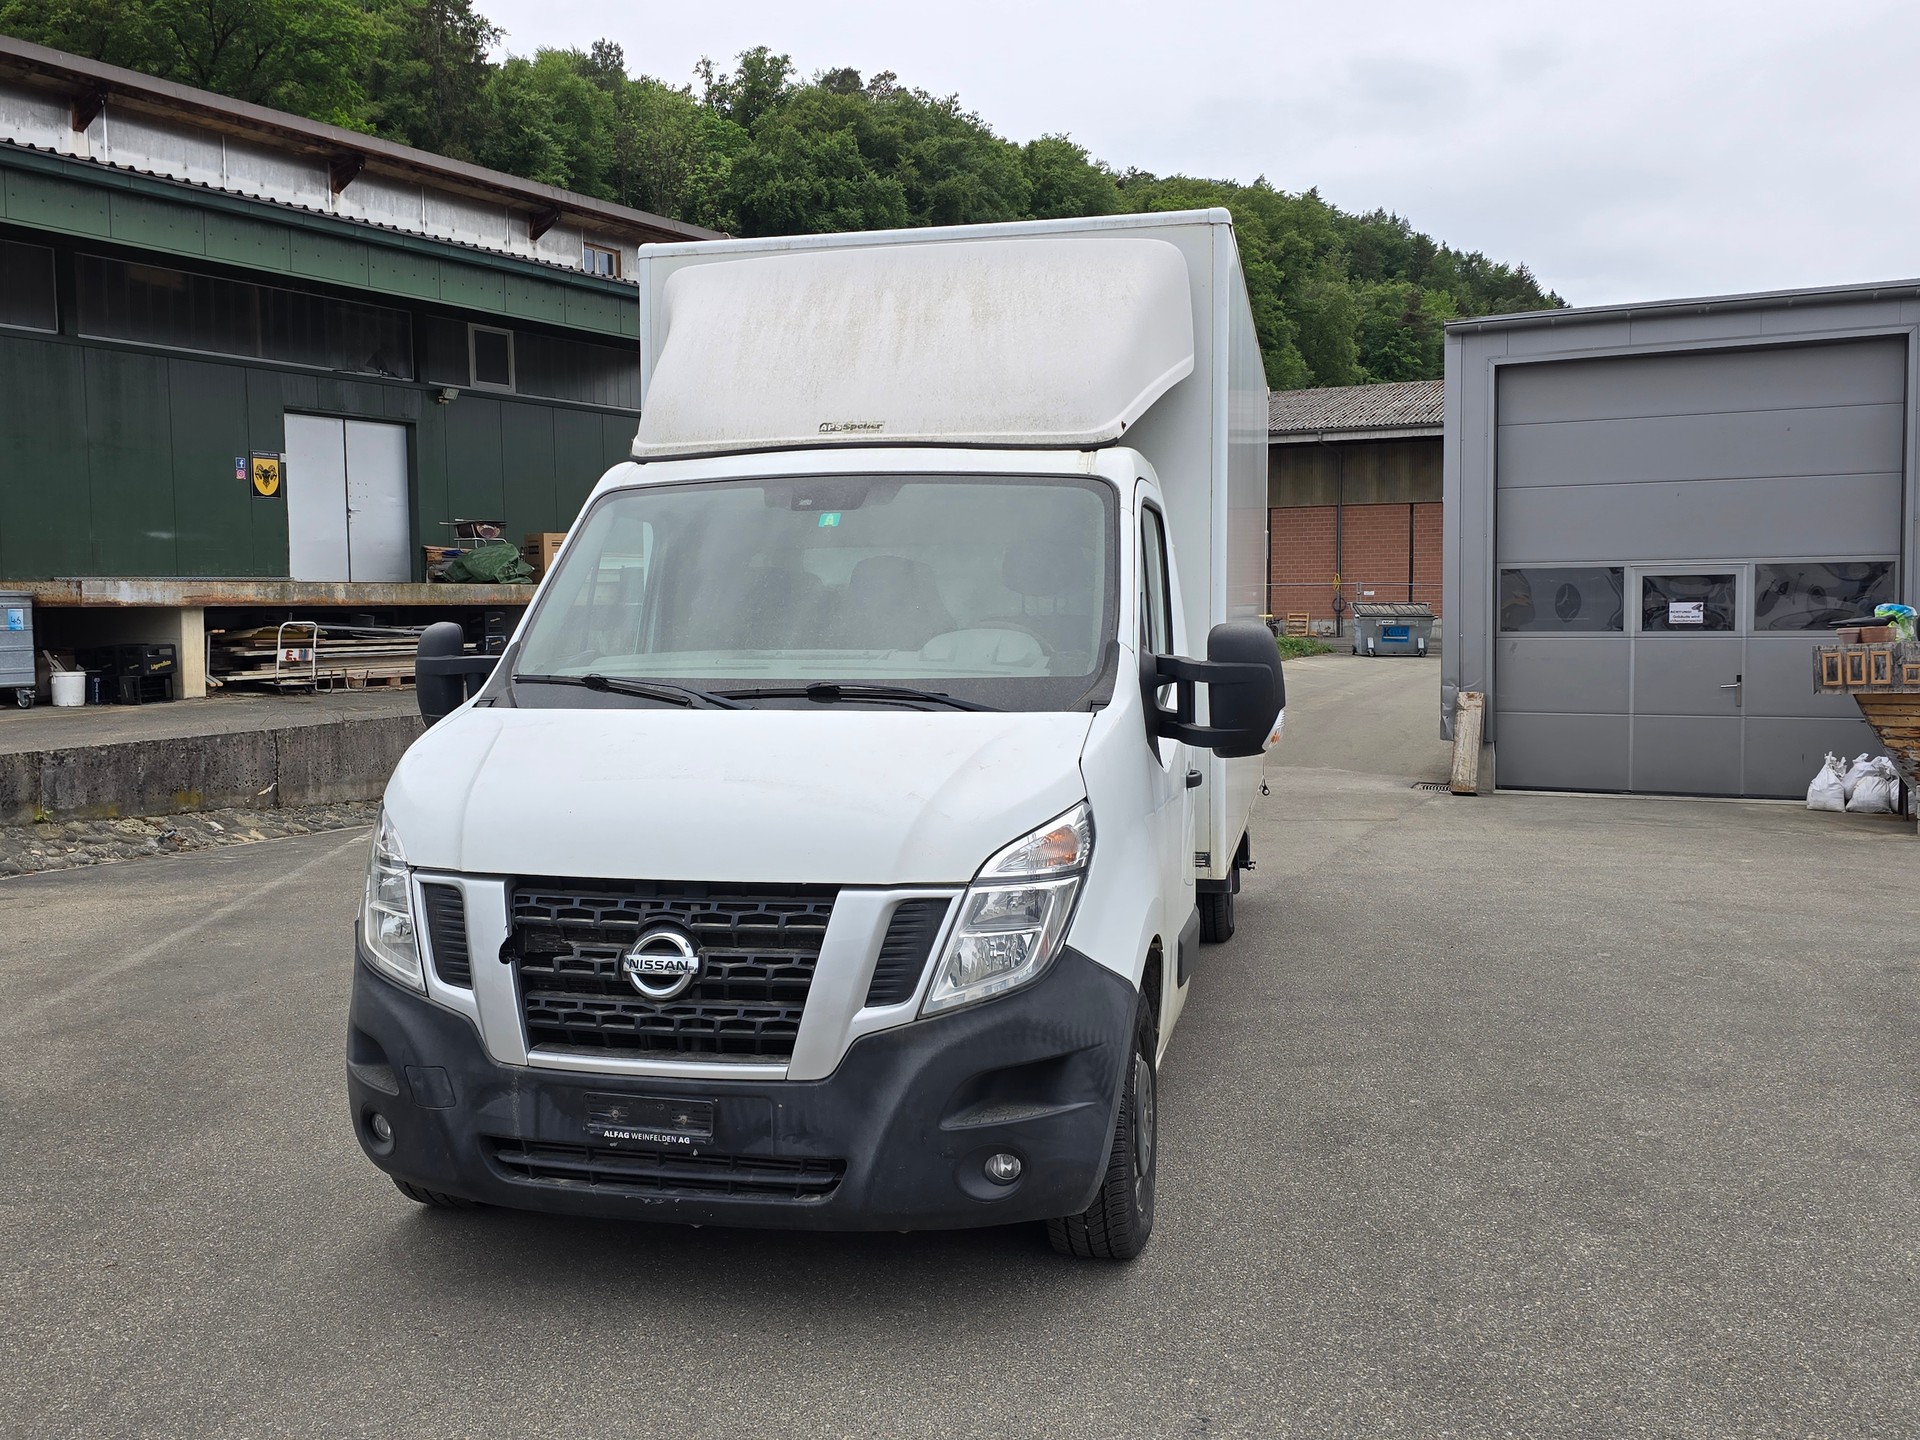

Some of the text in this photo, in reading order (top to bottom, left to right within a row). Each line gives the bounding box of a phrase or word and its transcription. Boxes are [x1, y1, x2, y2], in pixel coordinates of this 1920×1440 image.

[629, 958, 689, 971] NISSAN
[604, 1130, 690, 1144] ALFAG WEINFELDEN AG
